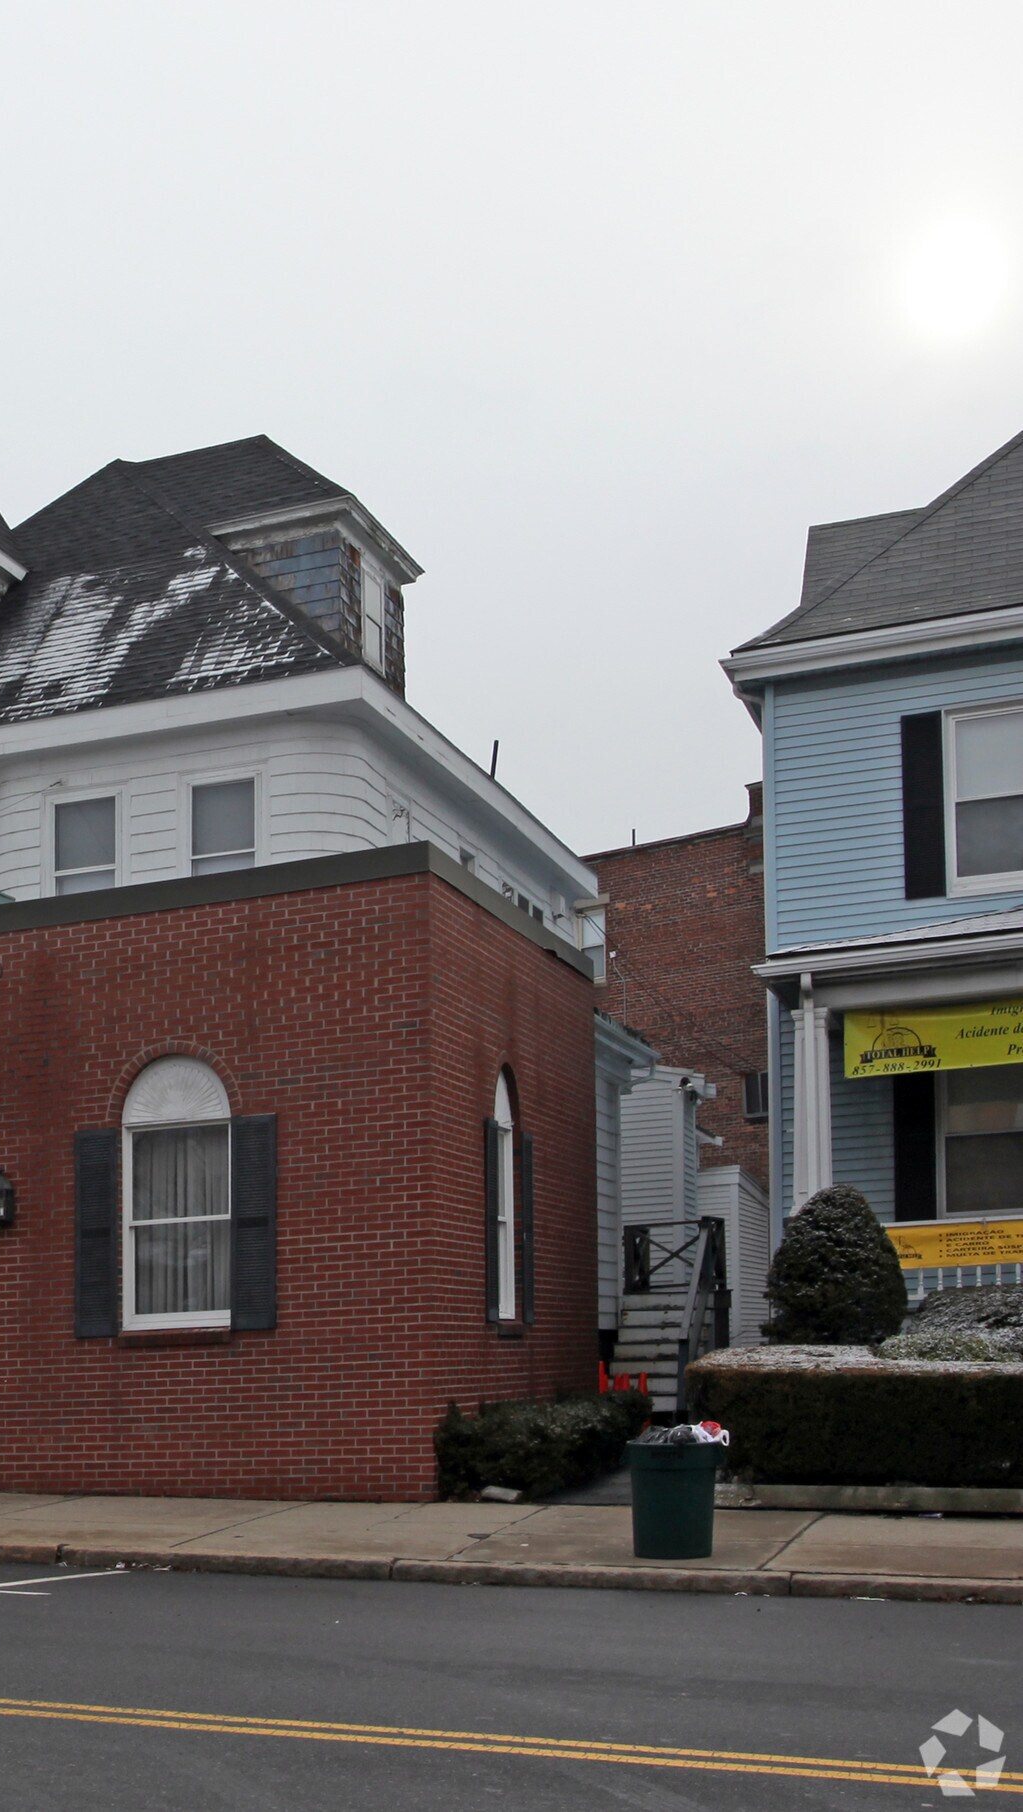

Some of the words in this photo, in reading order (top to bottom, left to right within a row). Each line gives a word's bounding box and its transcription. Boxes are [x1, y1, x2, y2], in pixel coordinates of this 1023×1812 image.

[955, 1025, 1010, 1039] Acidente
[866, 1049, 900, 1060] TOTAL
[902, 1046, 930, 1056] HELP
[852, 1059, 941, 1075] 857-888-2991
